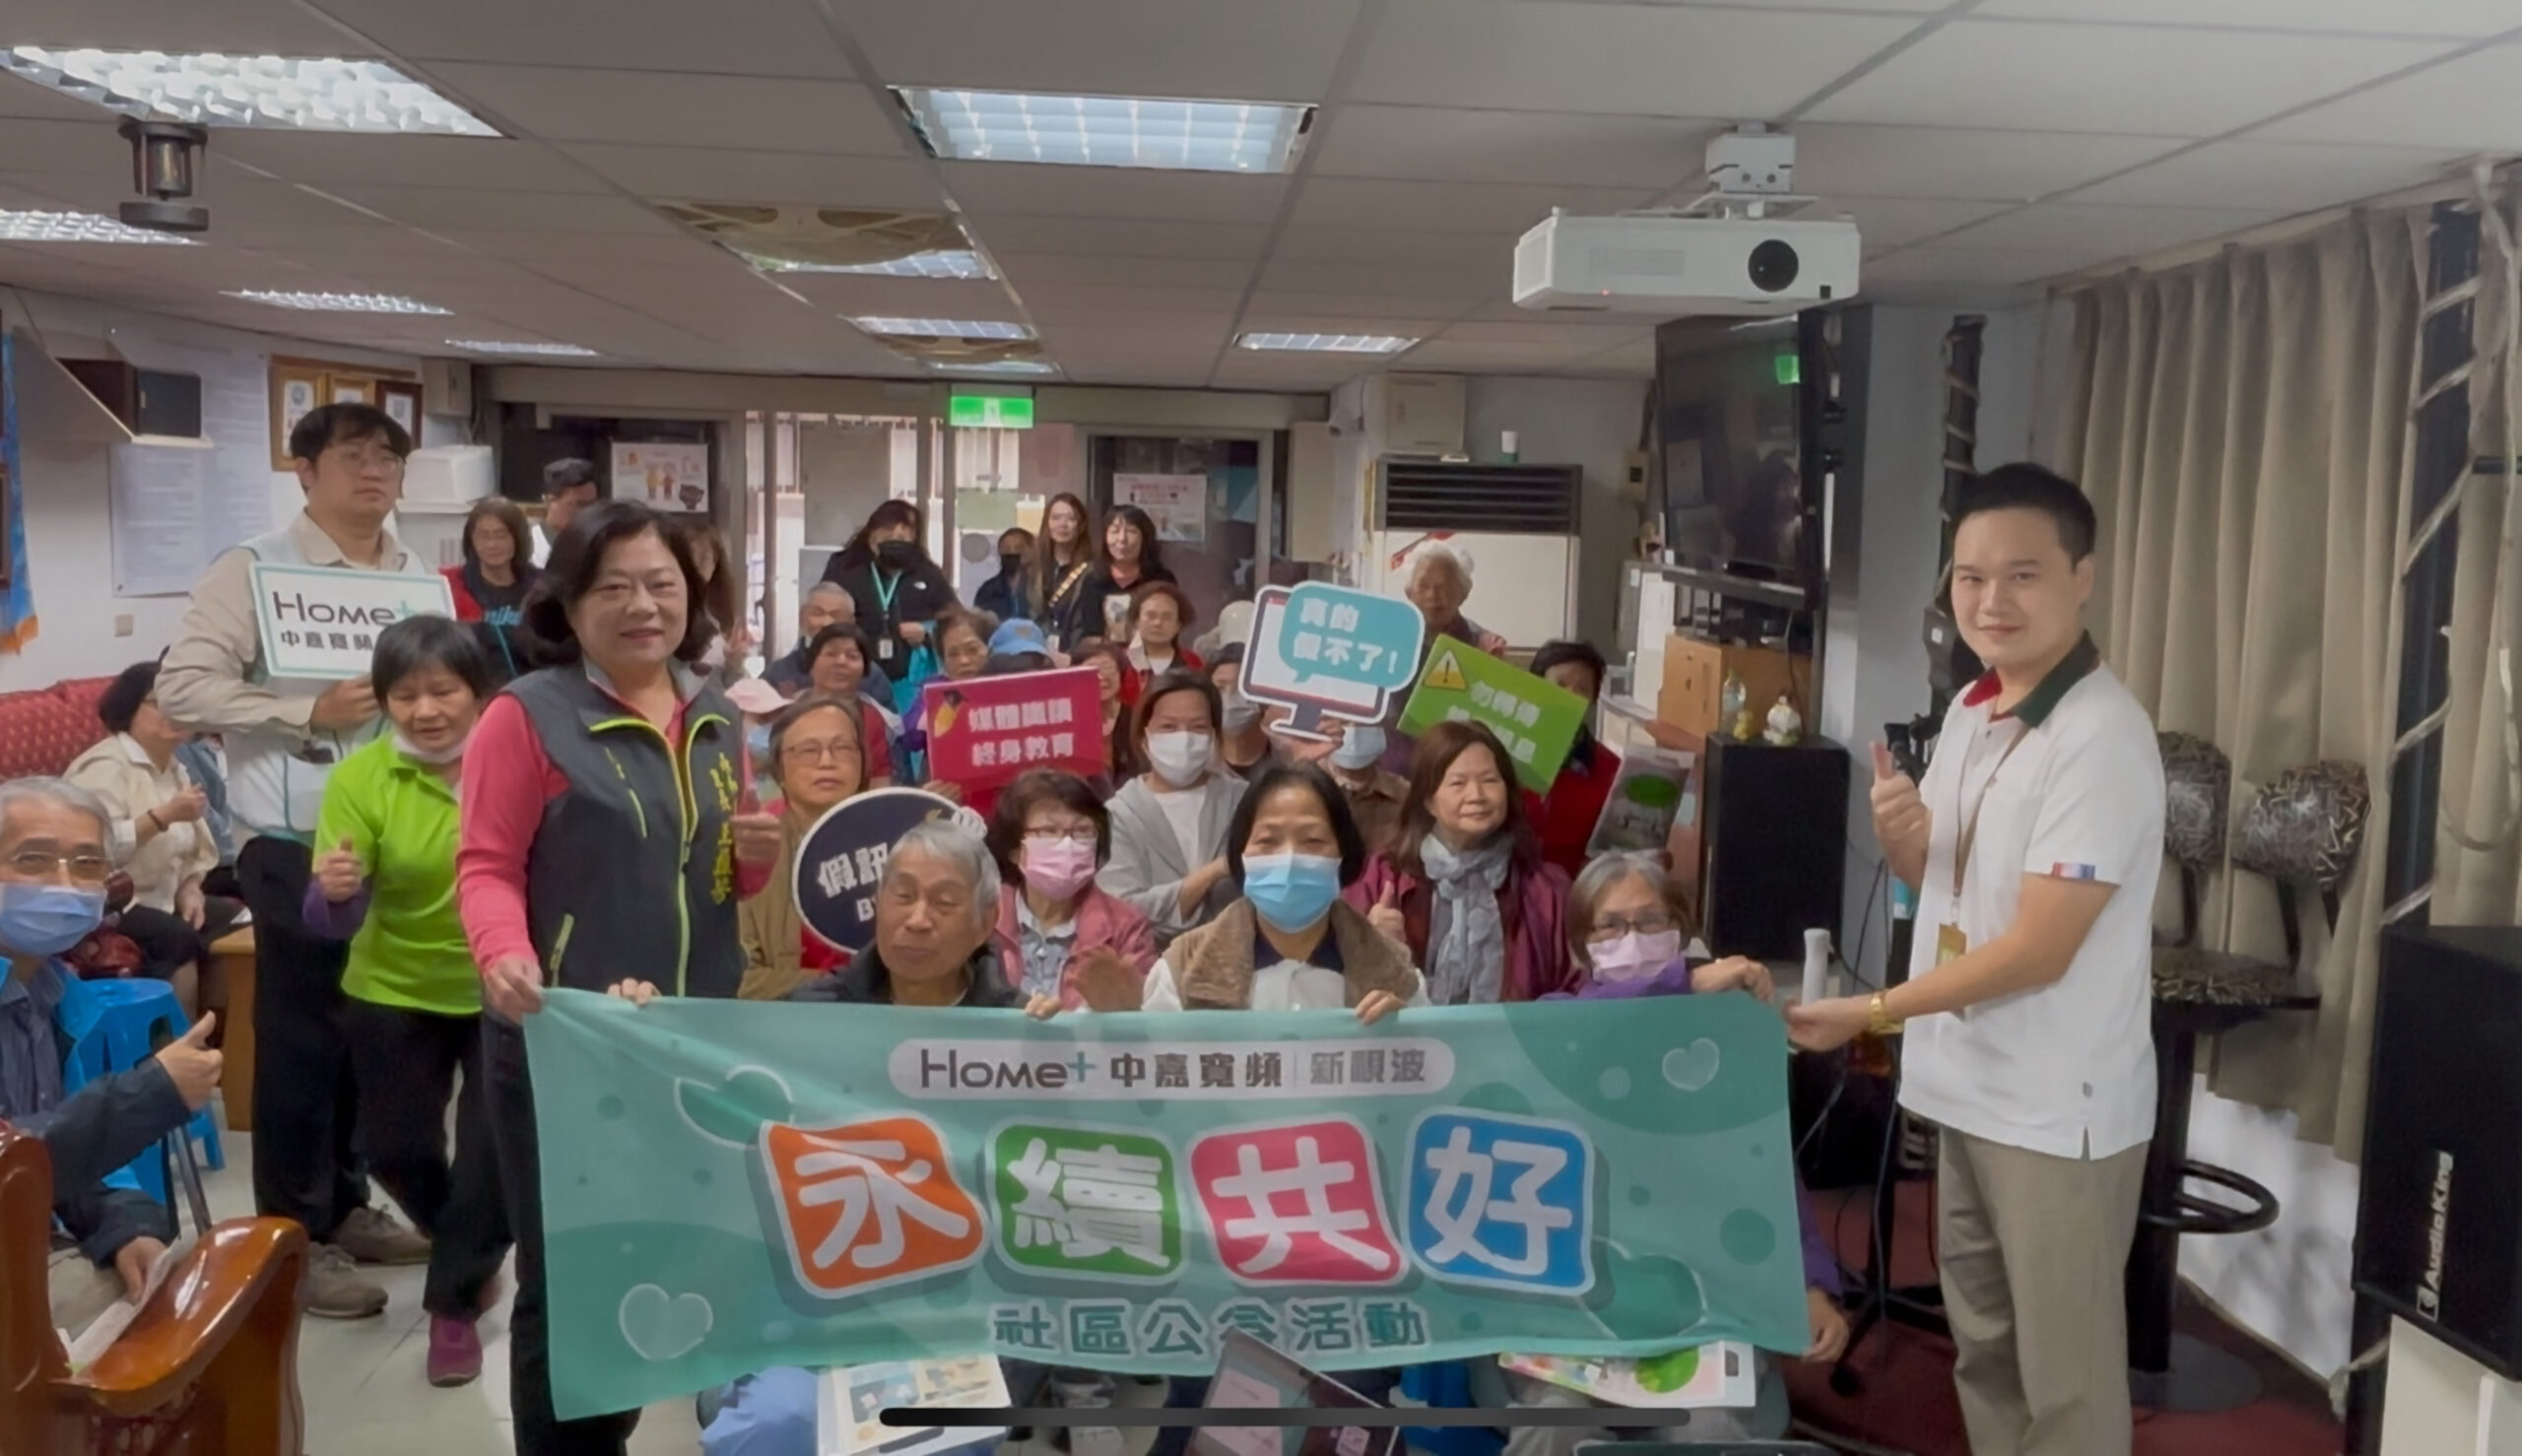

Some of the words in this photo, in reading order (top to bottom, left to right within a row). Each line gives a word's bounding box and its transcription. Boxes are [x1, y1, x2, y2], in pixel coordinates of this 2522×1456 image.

[921, 1048, 1096, 1089] Home+
[1110, 1052, 1283, 1089] 中嘉寬頻
[792, 1125, 1574, 1276] 永續共好
